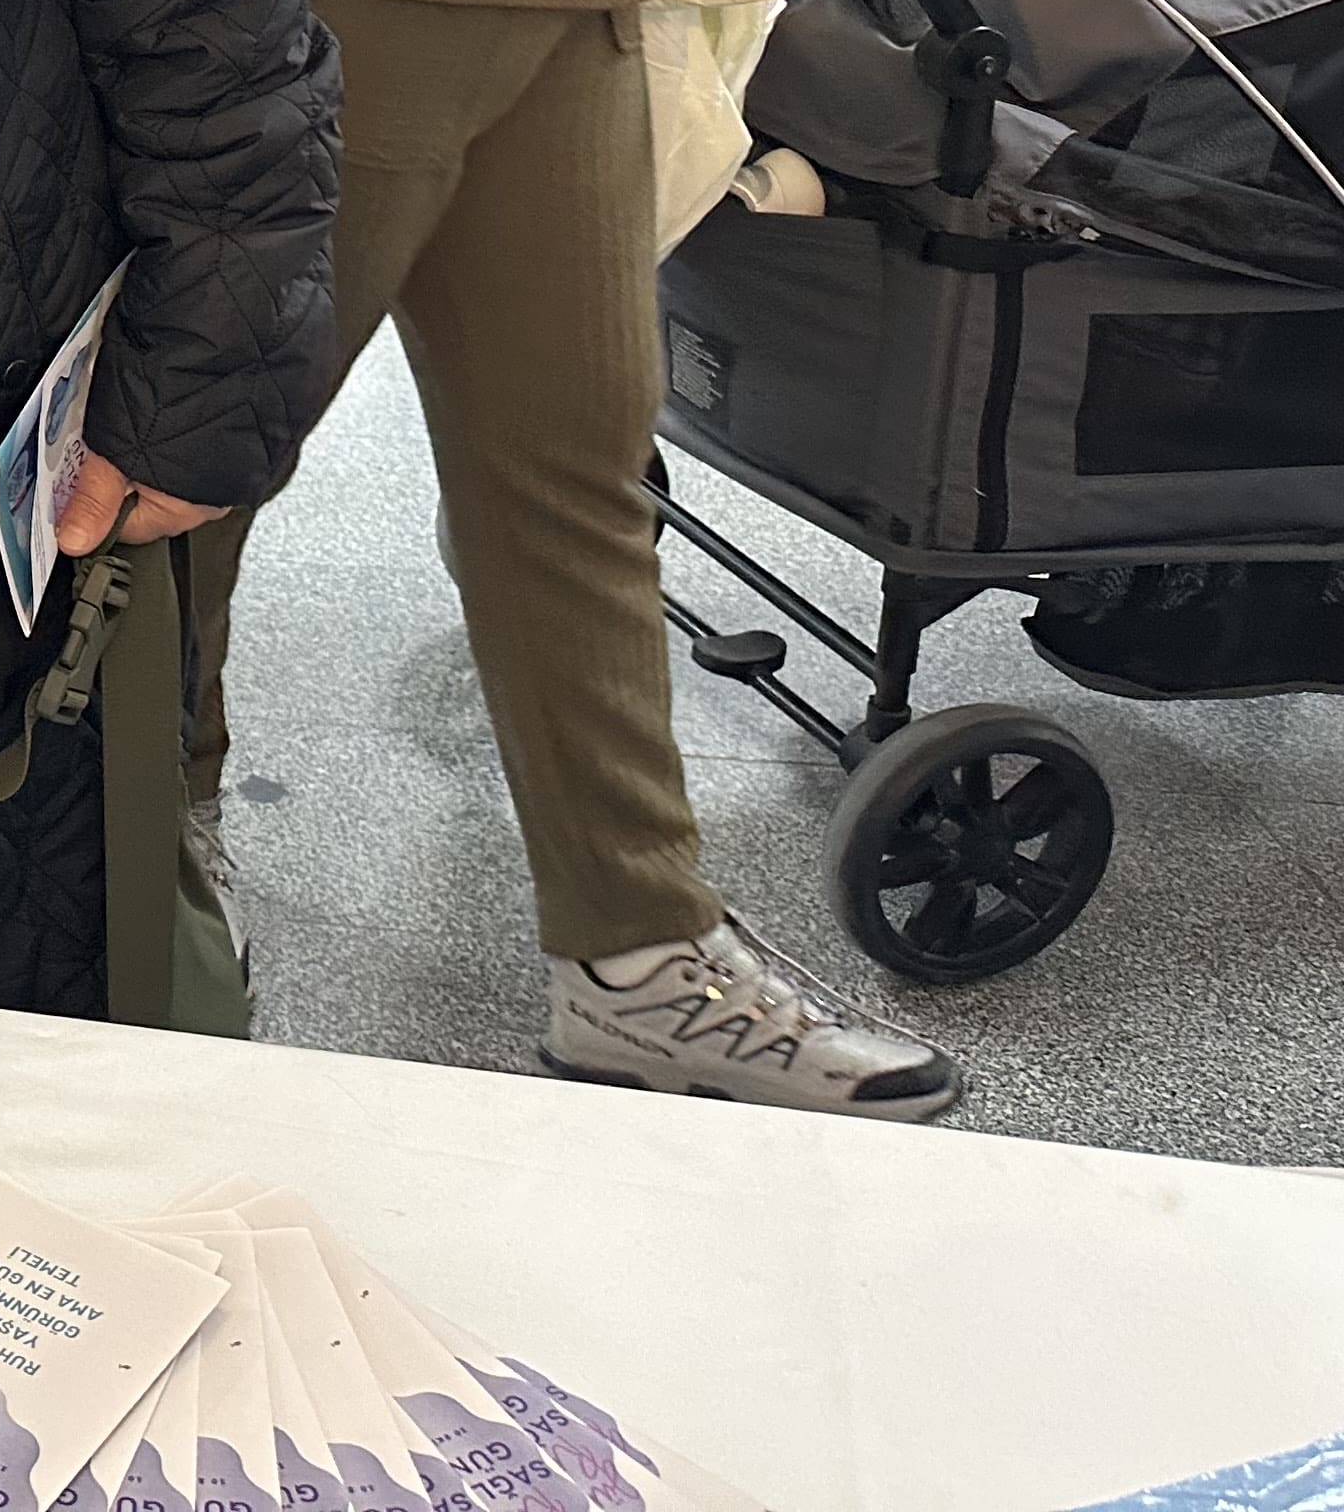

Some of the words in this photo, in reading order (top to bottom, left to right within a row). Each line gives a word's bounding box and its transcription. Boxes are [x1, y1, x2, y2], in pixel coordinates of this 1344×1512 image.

[6, 1246, 81, 1288] TEMELİ
[24, 1279, 56, 1301] EN
[58, 1294, 105, 1321] AMA
